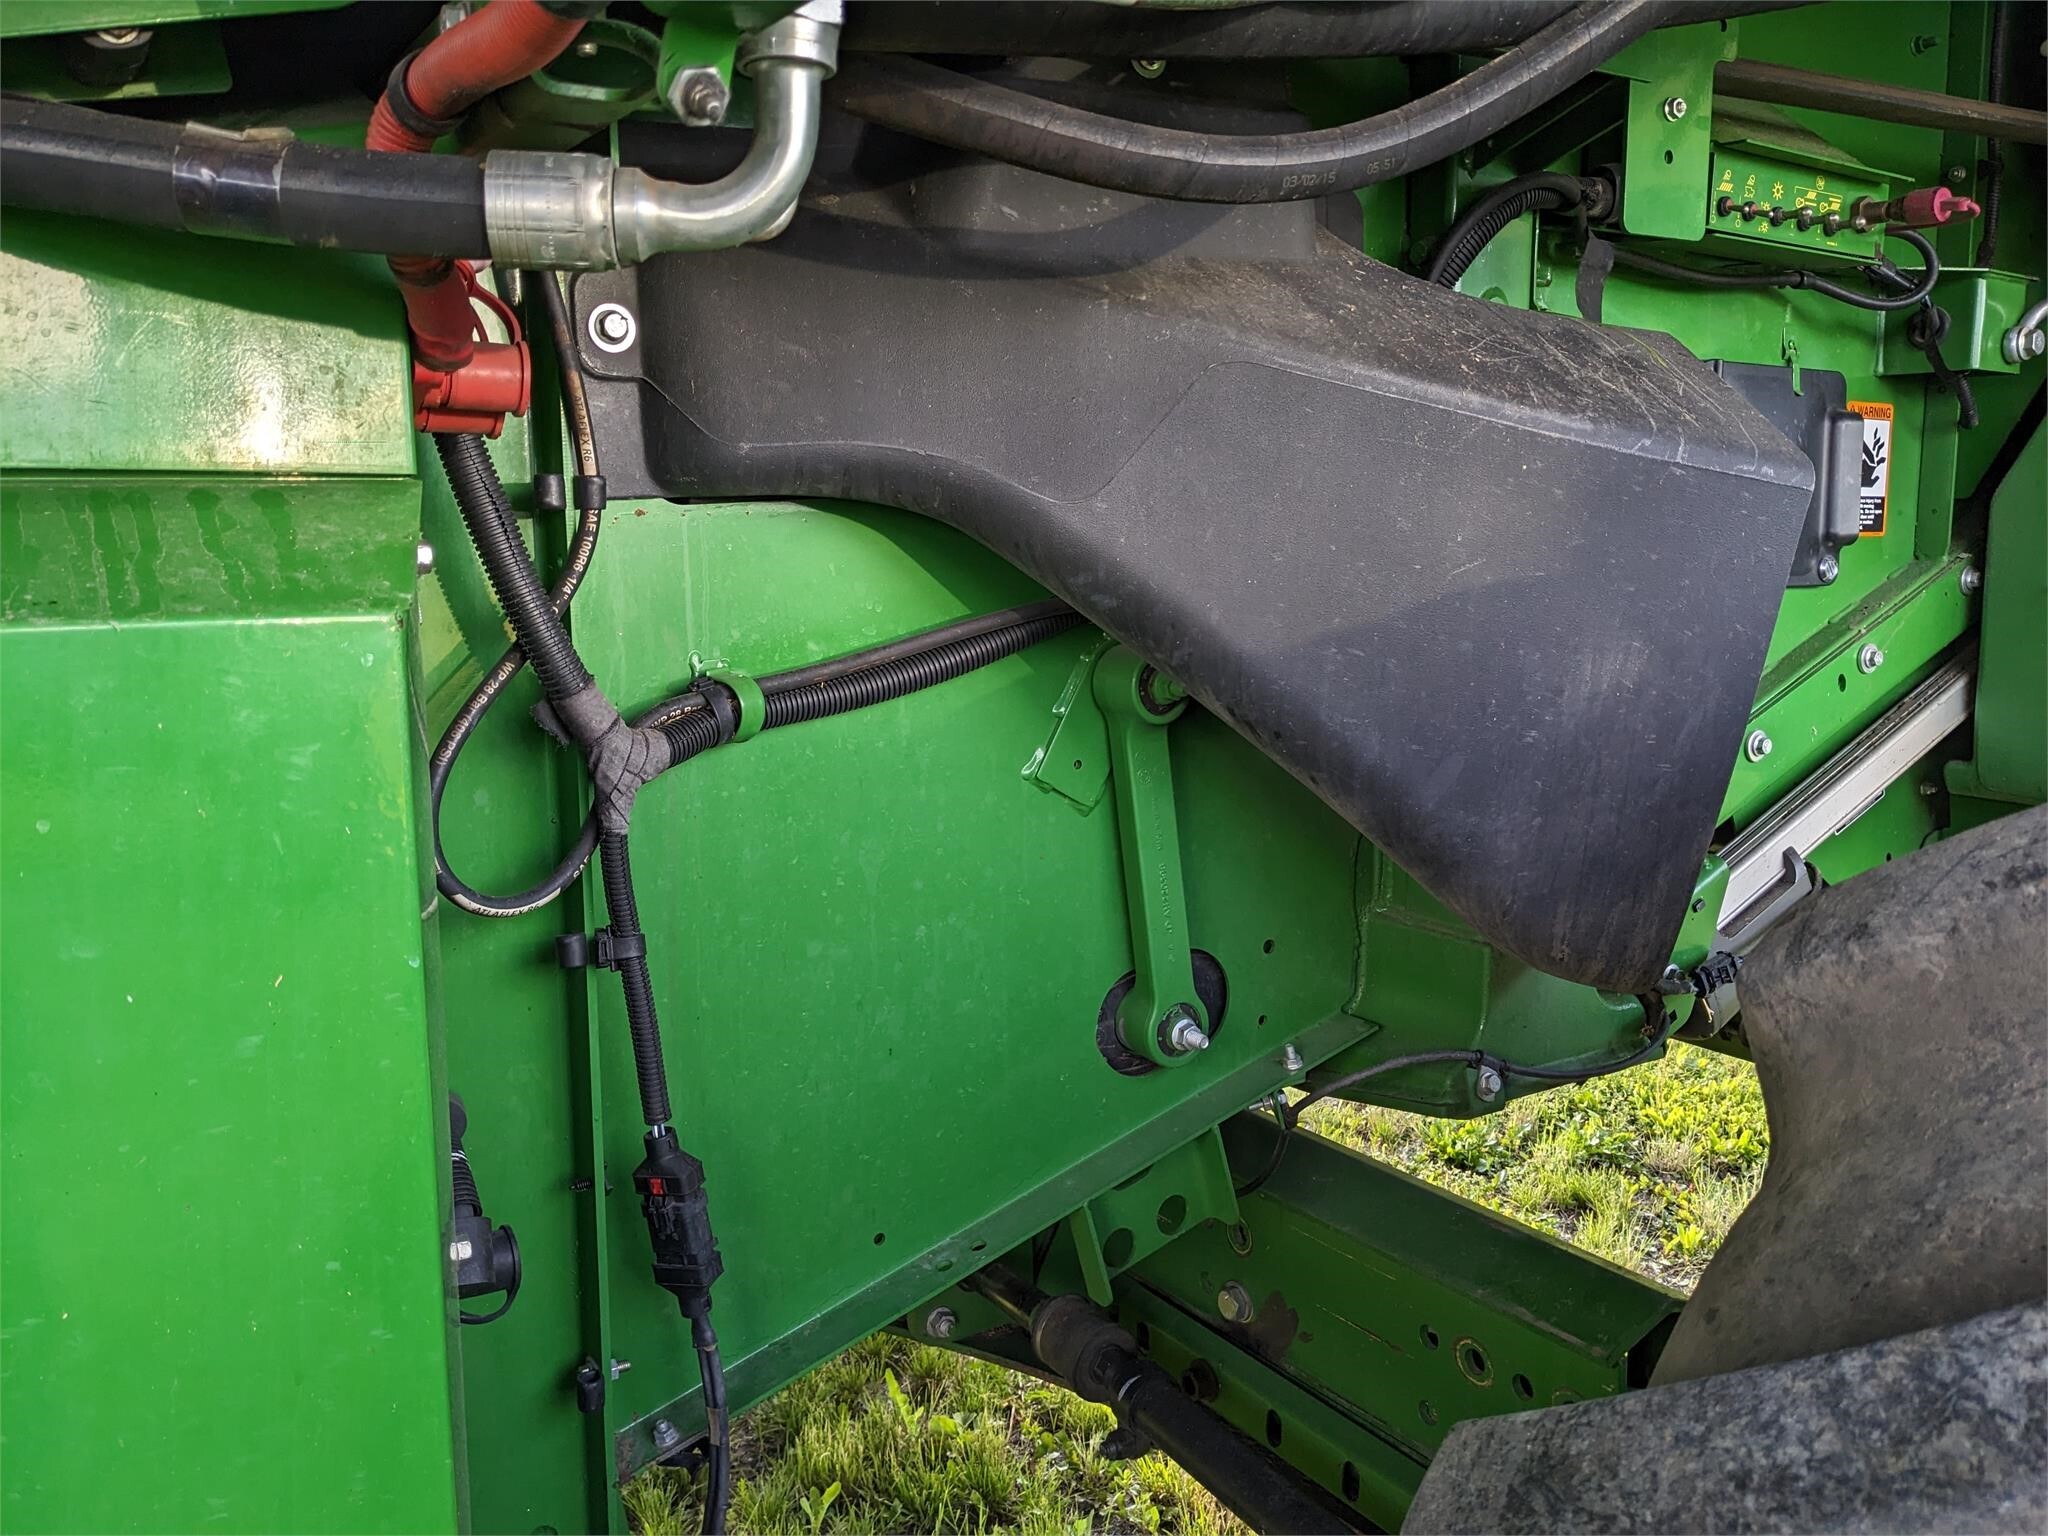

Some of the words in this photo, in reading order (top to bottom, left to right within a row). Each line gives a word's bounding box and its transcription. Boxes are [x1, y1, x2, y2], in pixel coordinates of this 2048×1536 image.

[1282, 171, 1336, 188] 03/02/15
[575, 395, 591, 446] ATLAFLEX
[1858, 405, 1891, 418] WARNING
[582, 448, 593, 462] R6
[585, 509, 599, 533] SAE
[573, 536, 593, 572] 100R6
[498, 661, 515, 681] WP
[483, 679, 499, 695] 28
[469, 693, 488, 714] Bar
[450, 714, 473, 740] (406
